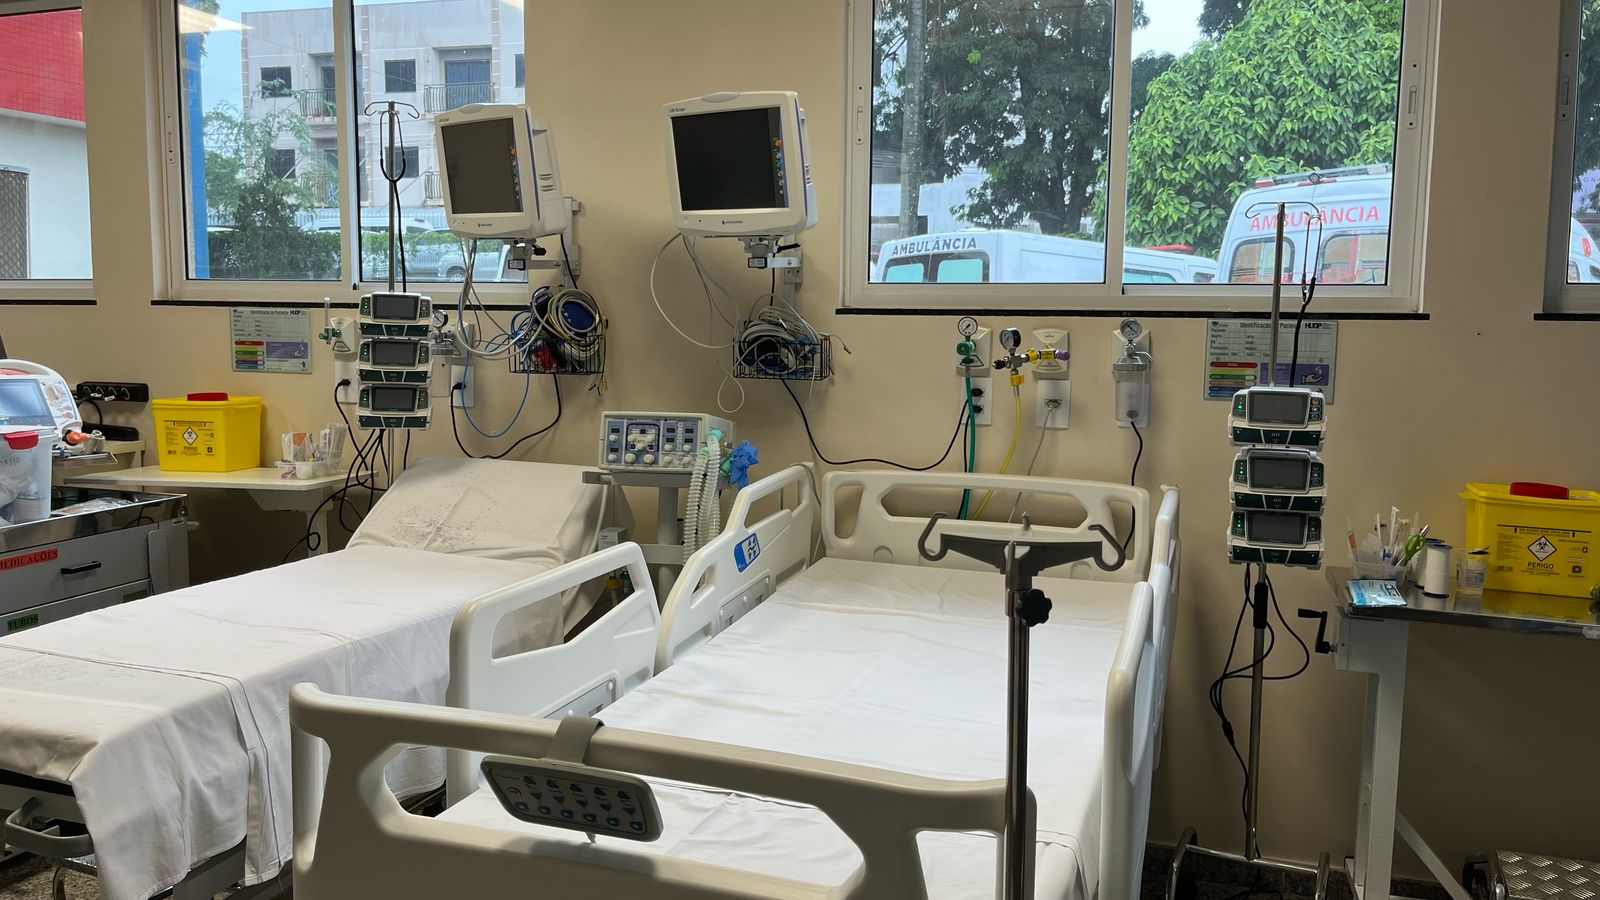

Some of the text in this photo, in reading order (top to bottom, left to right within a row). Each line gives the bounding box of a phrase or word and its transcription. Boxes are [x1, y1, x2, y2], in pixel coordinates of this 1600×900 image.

[891, 236, 977, 256] AMBULÂNCIA
[1527, 562, 1554, 570] PERIGO
[8, 613, 39, 630] TUBOS
